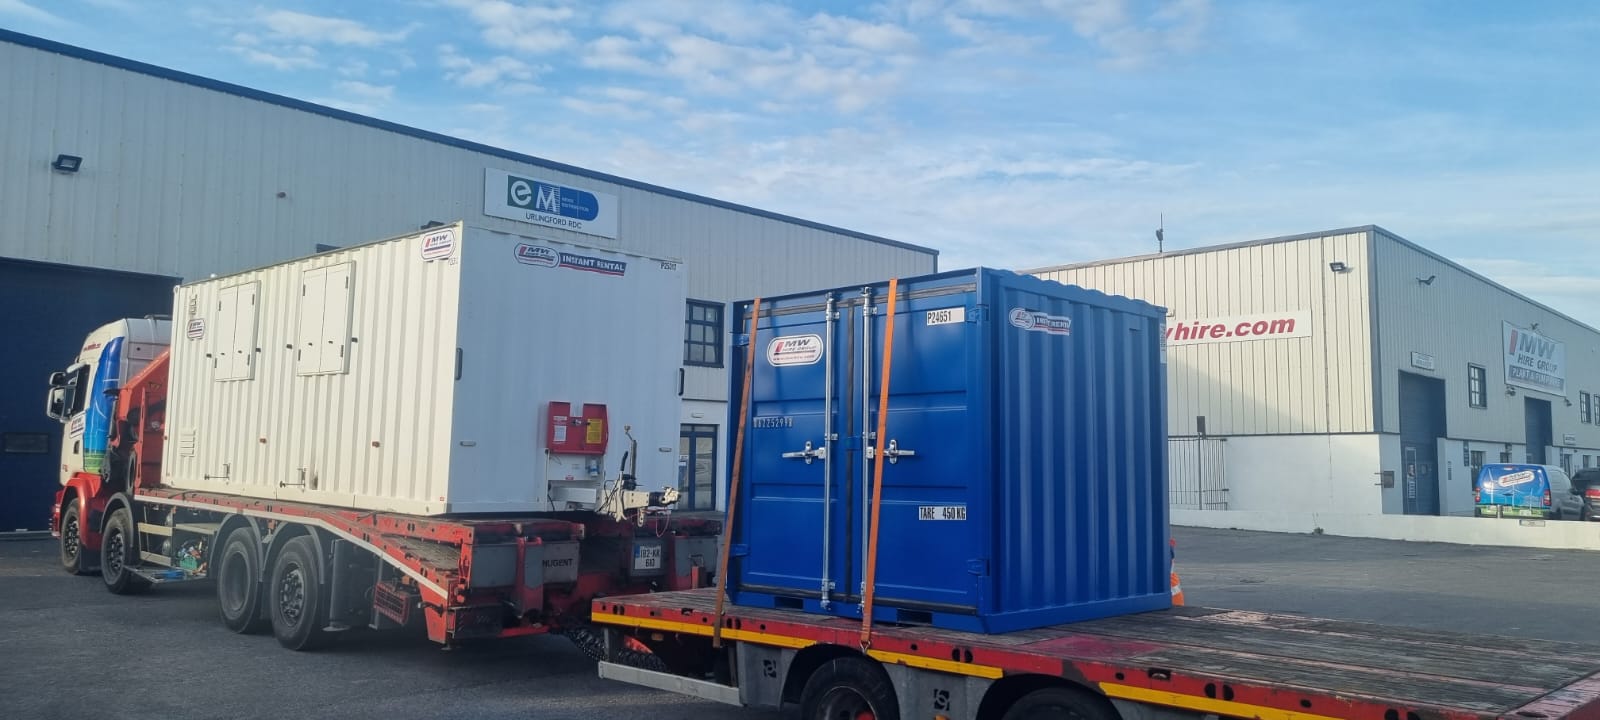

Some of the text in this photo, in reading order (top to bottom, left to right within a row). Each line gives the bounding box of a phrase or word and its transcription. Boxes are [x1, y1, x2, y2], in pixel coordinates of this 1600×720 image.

[525, 212, 582, 229] URLINGFORD RDC
[562, 255, 594, 268] INSTANT
[596, 261, 625, 271] RENTAL
[927, 311, 952, 324] P24651
[1166, 318, 1296, 341] hire.com
[1517, 353, 1534, 368] HIRE
[920, 507, 966, 520] TARE 450 KG
[542, 558, 573, 568] NUGENT
